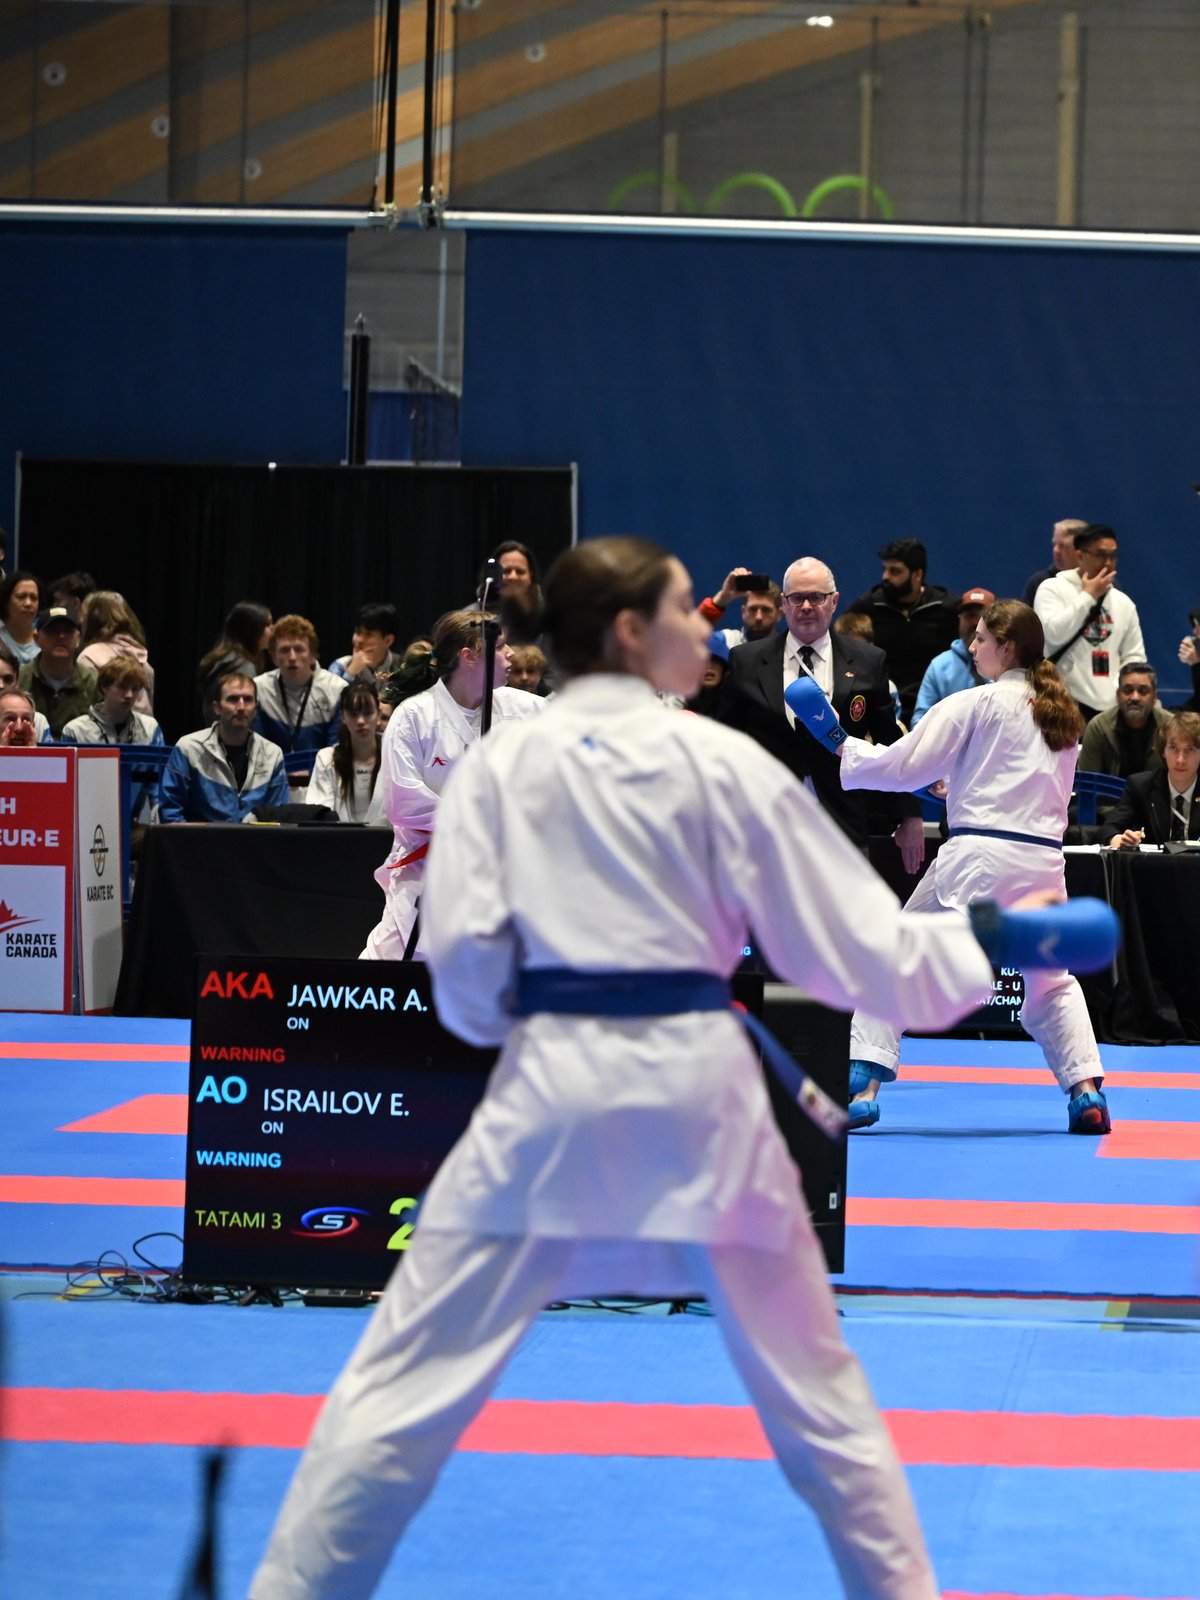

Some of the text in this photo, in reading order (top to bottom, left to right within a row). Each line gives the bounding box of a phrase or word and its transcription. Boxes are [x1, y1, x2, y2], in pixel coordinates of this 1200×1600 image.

[0, 829, 60, 847] UR·E
[87, 884, 114, 902] KARATE BC
[6, 933, 57, 945] KARATE
[6, 946, 58, 958] CANADA
[1001, 967, 1022, 976] KU-
[200, 970, 428, 1012] AKA JAWKAR A.
[991, 981, 1003, 990] LE
[1013, 981, 1021, 991] U
[286, 1016, 309, 1031] ON
[201, 1046, 286, 1063] WARNING
[196, 1075, 410, 1116] AO ISRAILOV E.
[261, 1121, 284, 1134] ON
[196, 1150, 282, 1168] WARNING
[195, 1209, 265, 1229] TATAMI
[271, 1212, 282, 1230] 3
